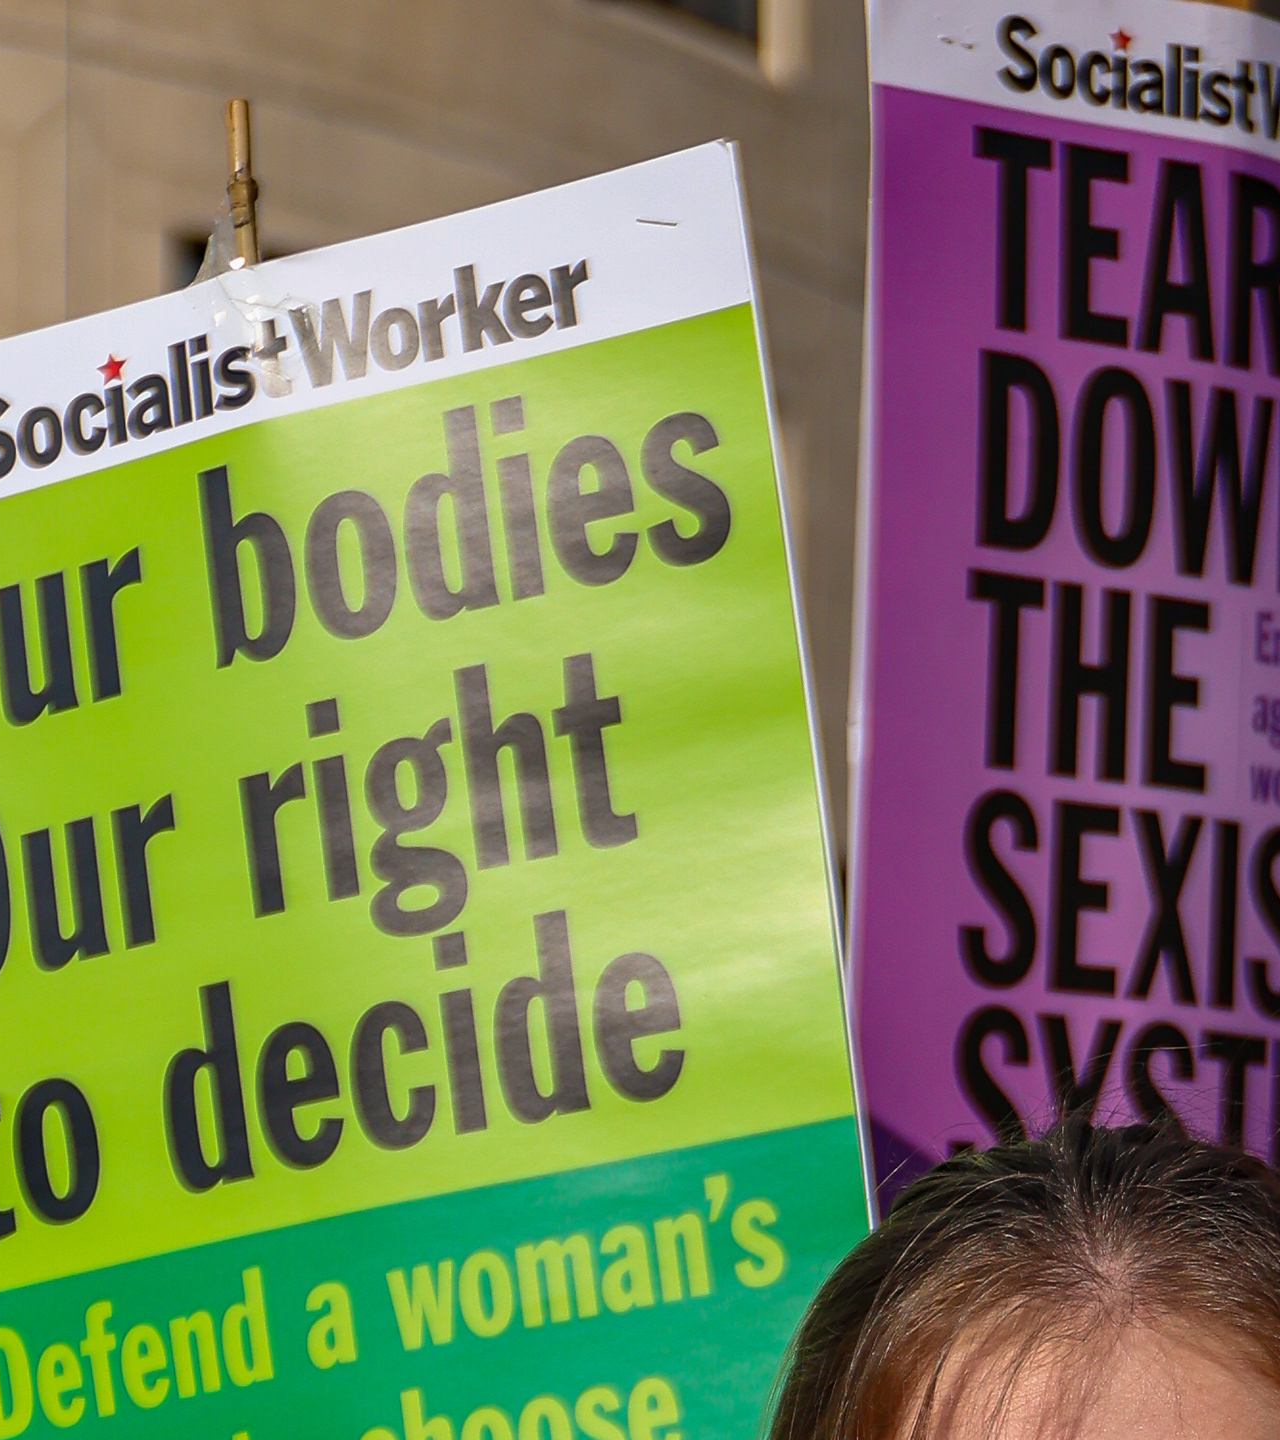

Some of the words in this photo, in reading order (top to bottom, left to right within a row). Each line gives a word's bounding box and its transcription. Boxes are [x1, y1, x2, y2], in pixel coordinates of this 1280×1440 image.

[197, 395, 732, 671] bodies
[237, 652, 640, 940] right
[965, 569, 1211, 794] THE
[162, 909, 685, 1195] decide
[306, 1277, 357, 1369] a
[387, 1171, 786, 1352] woman's
